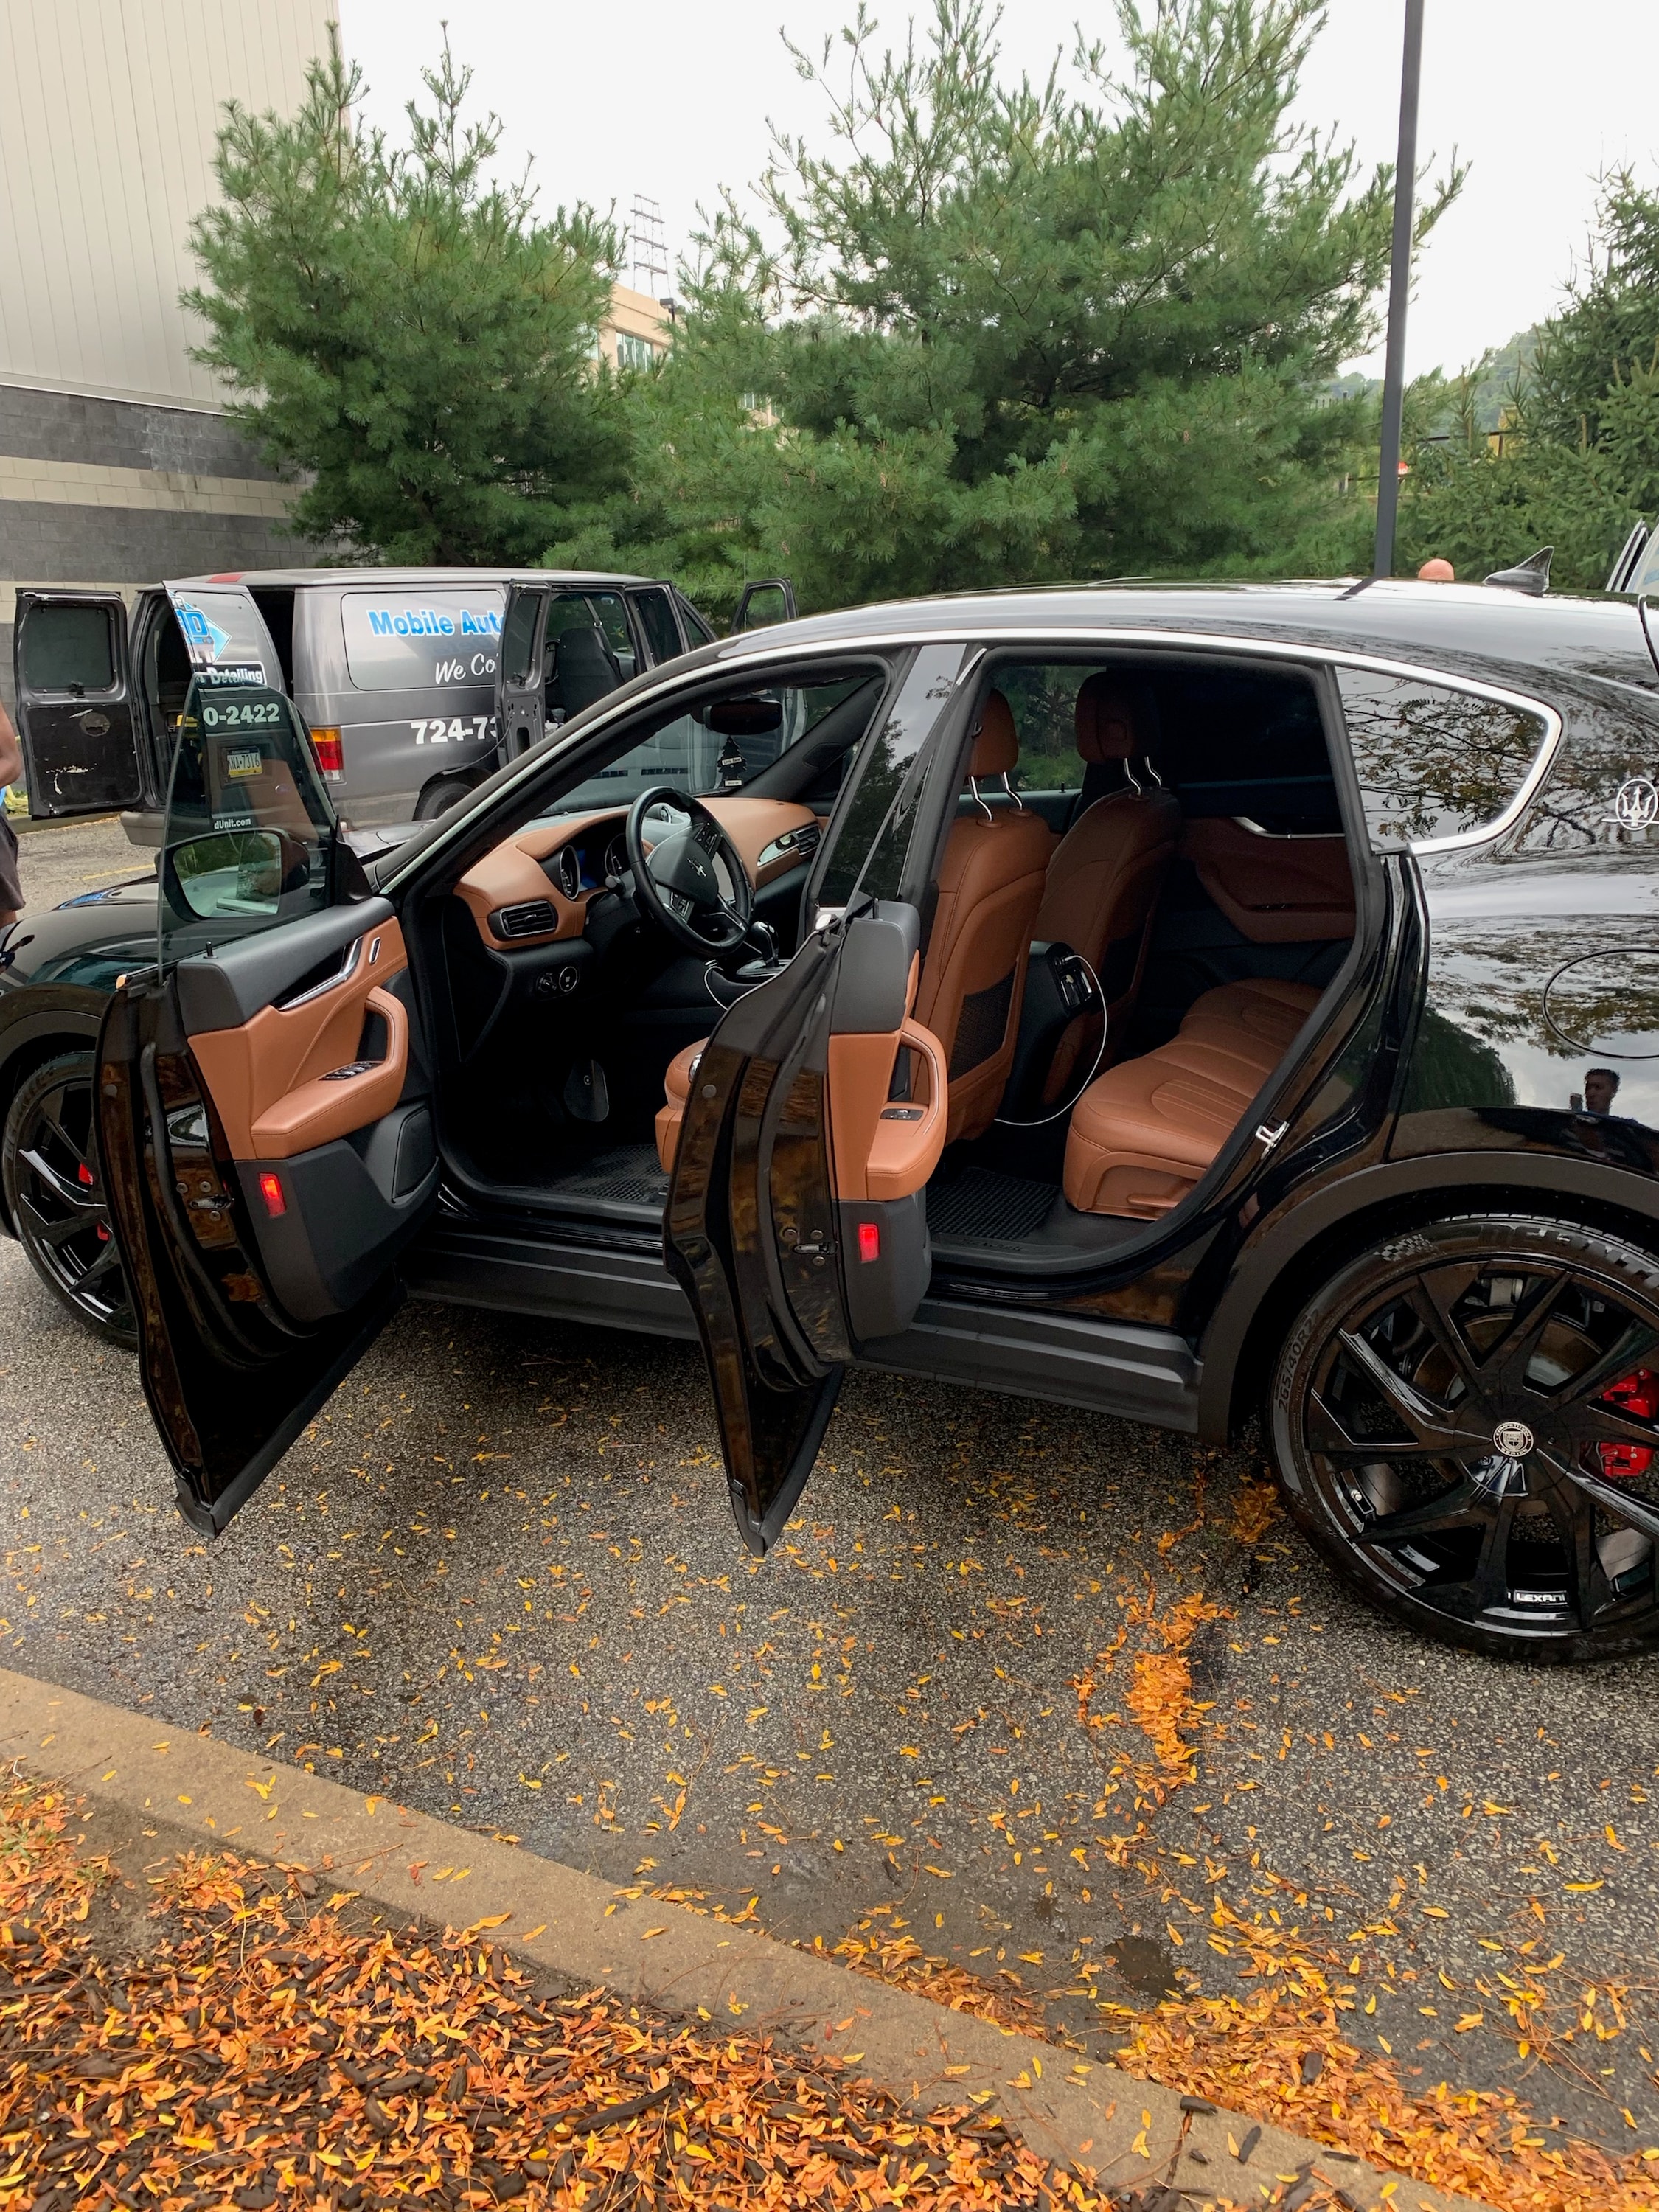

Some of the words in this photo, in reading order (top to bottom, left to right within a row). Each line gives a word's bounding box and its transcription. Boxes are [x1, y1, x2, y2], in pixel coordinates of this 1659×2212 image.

[367, 610, 454, 636] Mobile
[460, 609, 504, 636] Aut
[206, 667, 263, 684] Detailing
[435, 658, 466, 684] We
[470, 653, 496, 675] Co
[203, 703, 279, 726] 0-2422
[214, 818, 251, 830] dUnit.com
